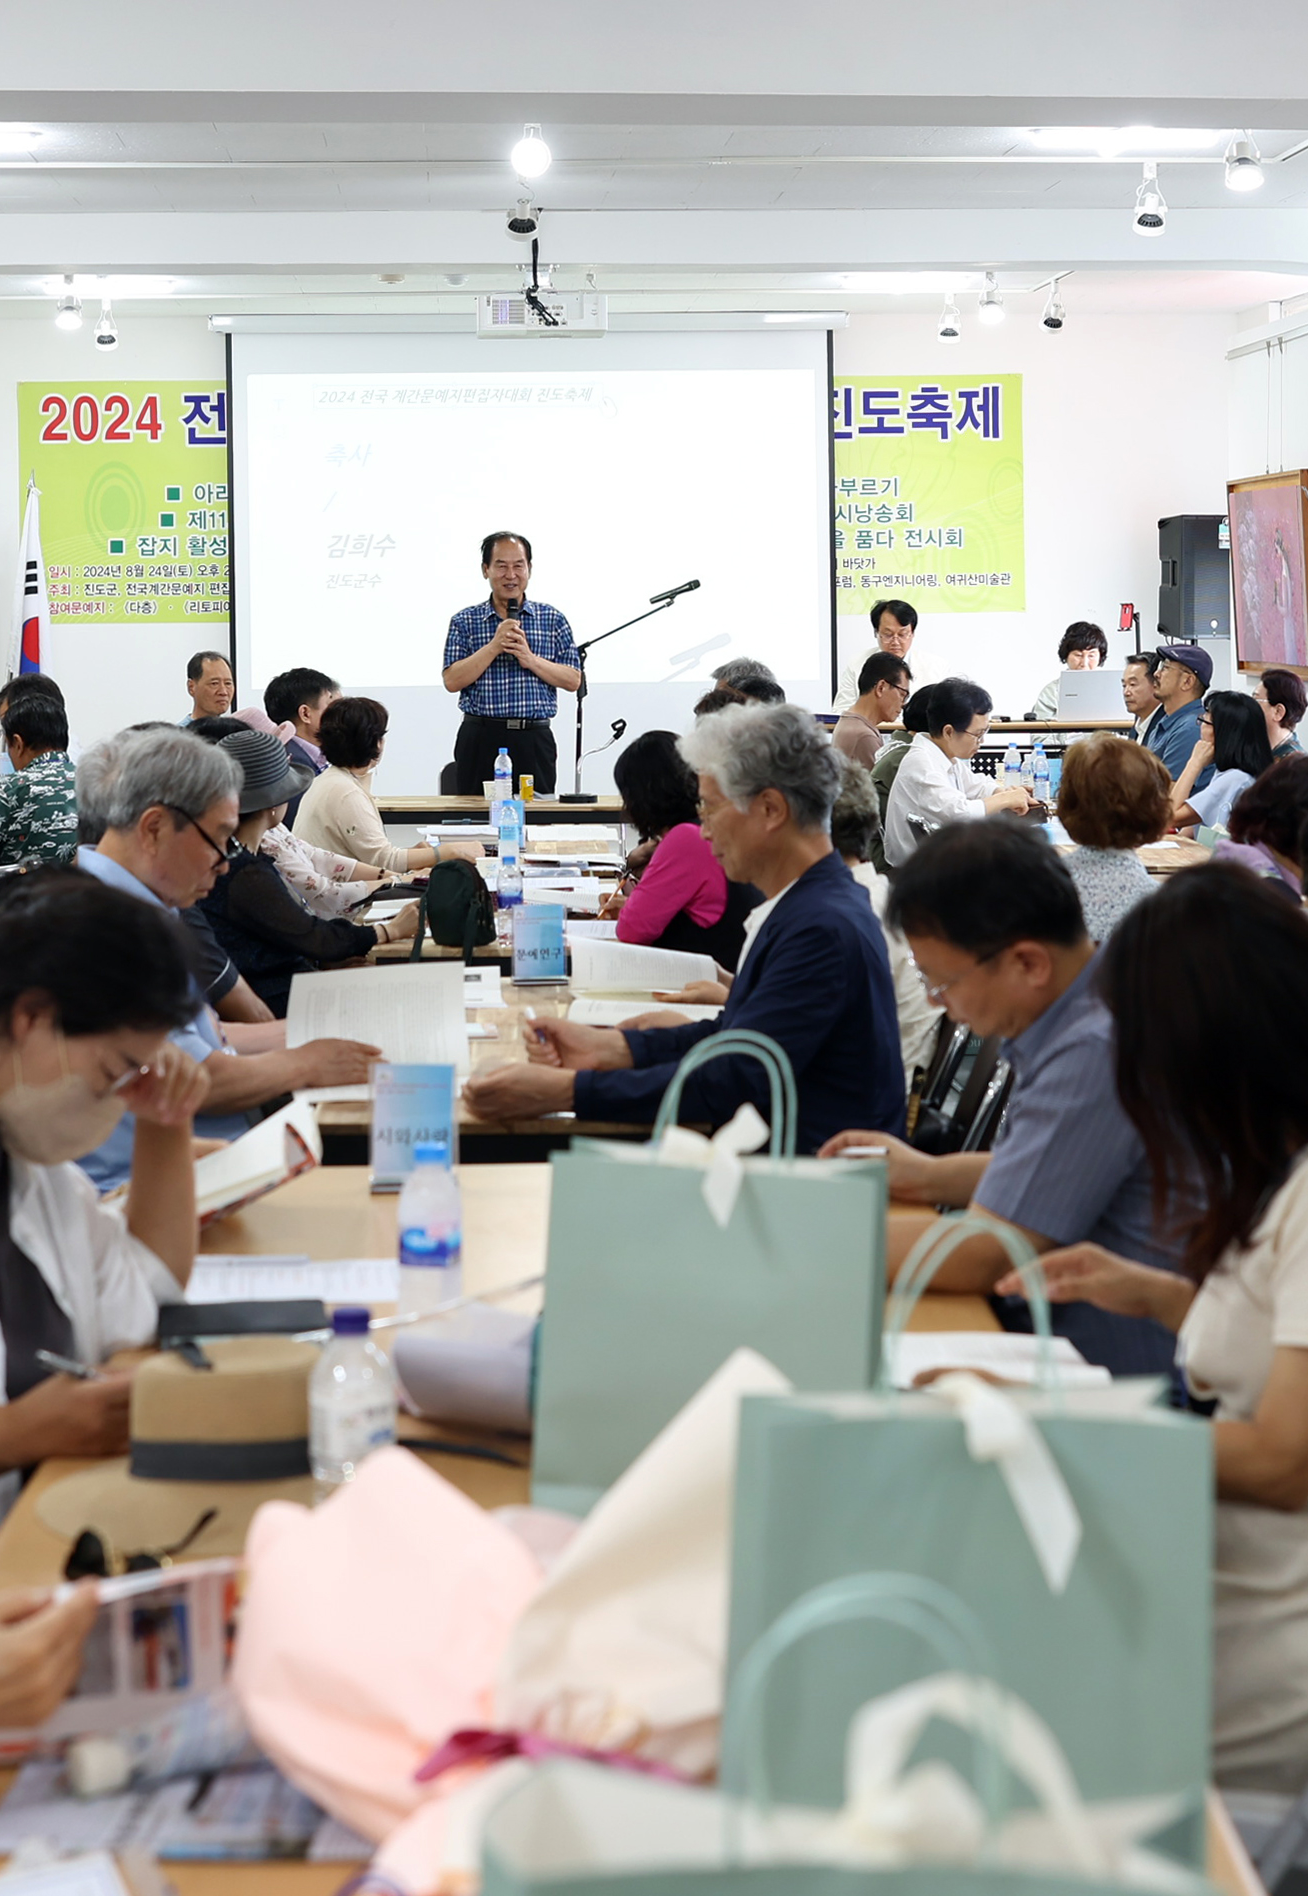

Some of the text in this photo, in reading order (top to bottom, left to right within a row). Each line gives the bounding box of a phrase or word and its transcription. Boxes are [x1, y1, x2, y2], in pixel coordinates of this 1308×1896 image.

[317, 390, 357, 404] 2024
[360, 388, 389, 405] 전국
[536, 386, 593, 403] 진도축제
[41, 391, 228, 445] 2024 전
[835, 477, 898, 498] 부르기
[835, 503, 913, 524] 시낭송회
[137, 536, 228, 556] 잡지 활성
[326, 532, 397, 559] 김희수
[855, 529, 895, 549] 품다
[904, 528, 963, 548] 전시회
[48, 565, 71, 578] 일시
[83, 564, 121, 578] 2024년
[125, 564, 144, 578] 8월
[197, 563, 220, 577] 오후
[842, 557, 877, 570] 바닷가
[325, 573, 384, 589] 진도군수
[945, 572, 1011, 586] 여귀산미술관
[48, 583, 71, 597] 주최
[125, 582, 206, 597] 전국계간문예지
